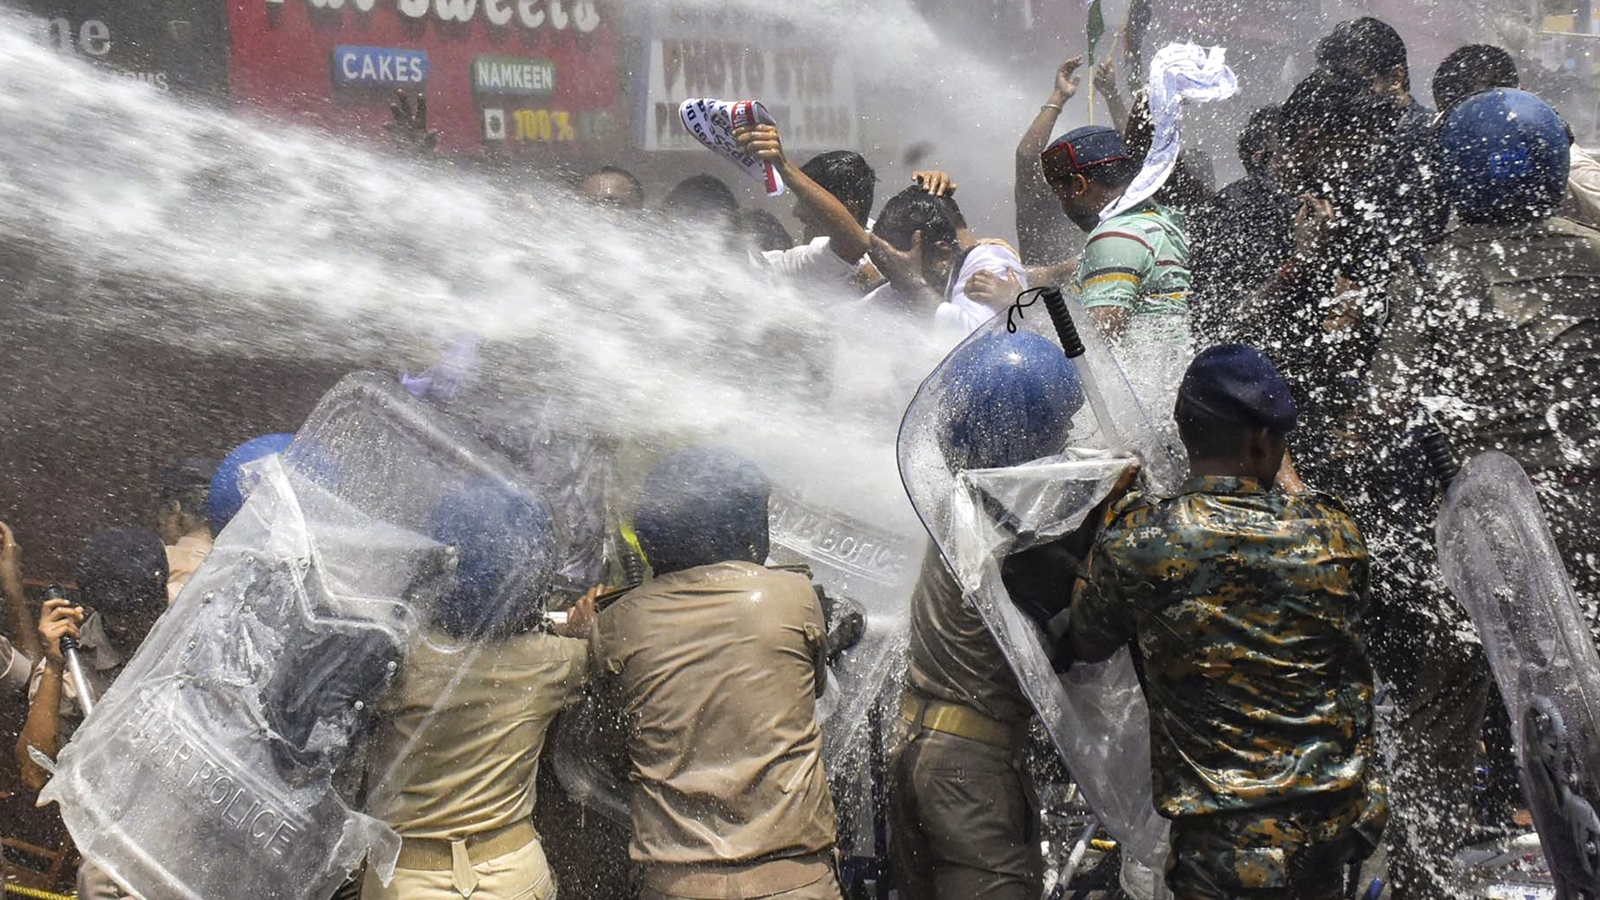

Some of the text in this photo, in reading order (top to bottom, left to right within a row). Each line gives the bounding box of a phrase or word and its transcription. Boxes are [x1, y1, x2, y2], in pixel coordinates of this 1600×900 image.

[342, 53, 423, 82] CAKES
[477, 60, 554, 90] NAMKEEN
[513, 109, 575, 142] 100%
[185, 760, 299, 856] POLICE
